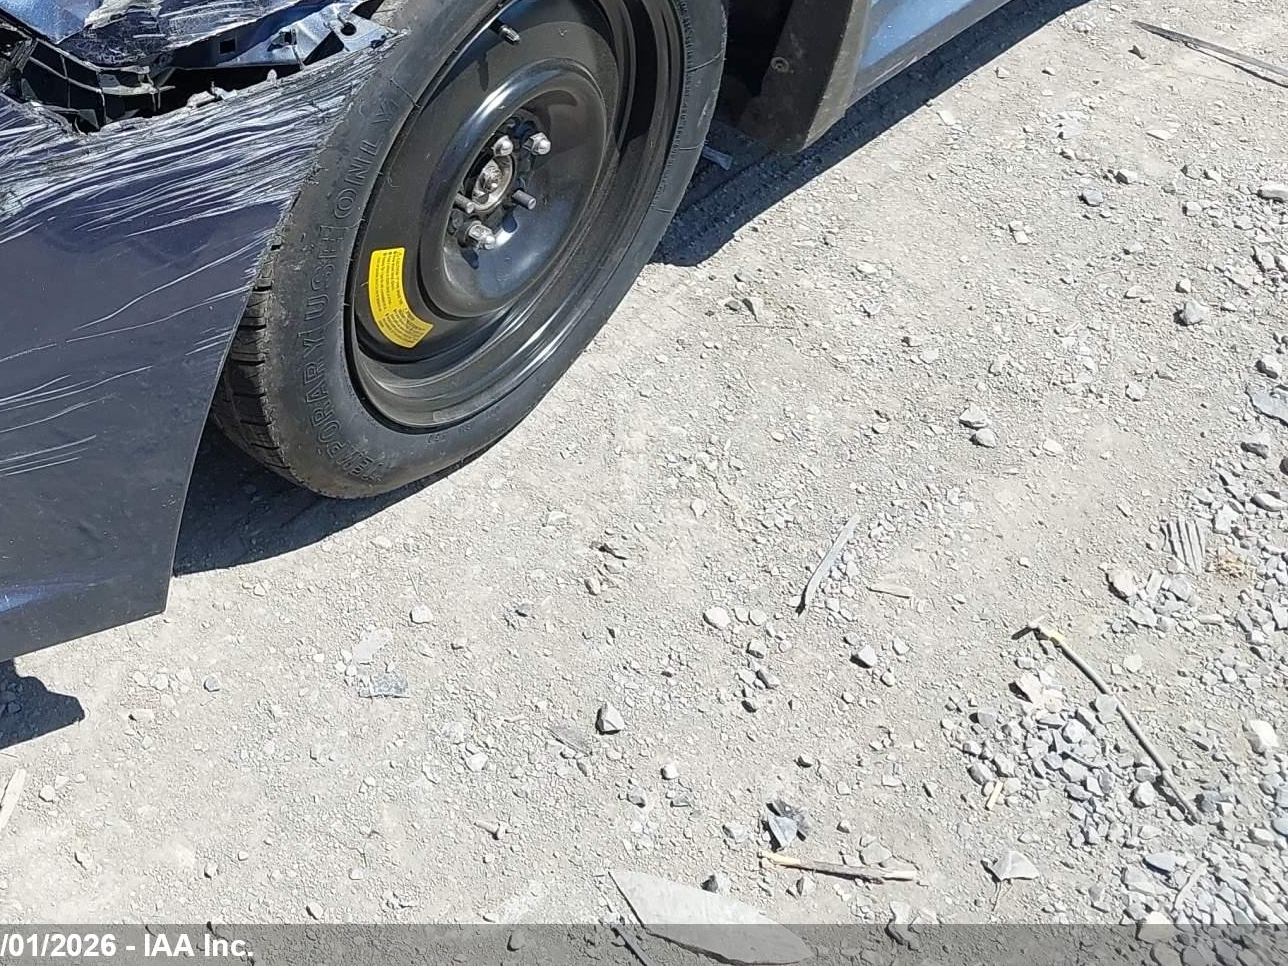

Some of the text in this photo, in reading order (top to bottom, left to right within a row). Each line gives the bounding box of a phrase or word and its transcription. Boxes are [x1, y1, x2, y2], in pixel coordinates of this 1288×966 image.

[301, 96, 400, 481] TEMPORARY USE ONLY
